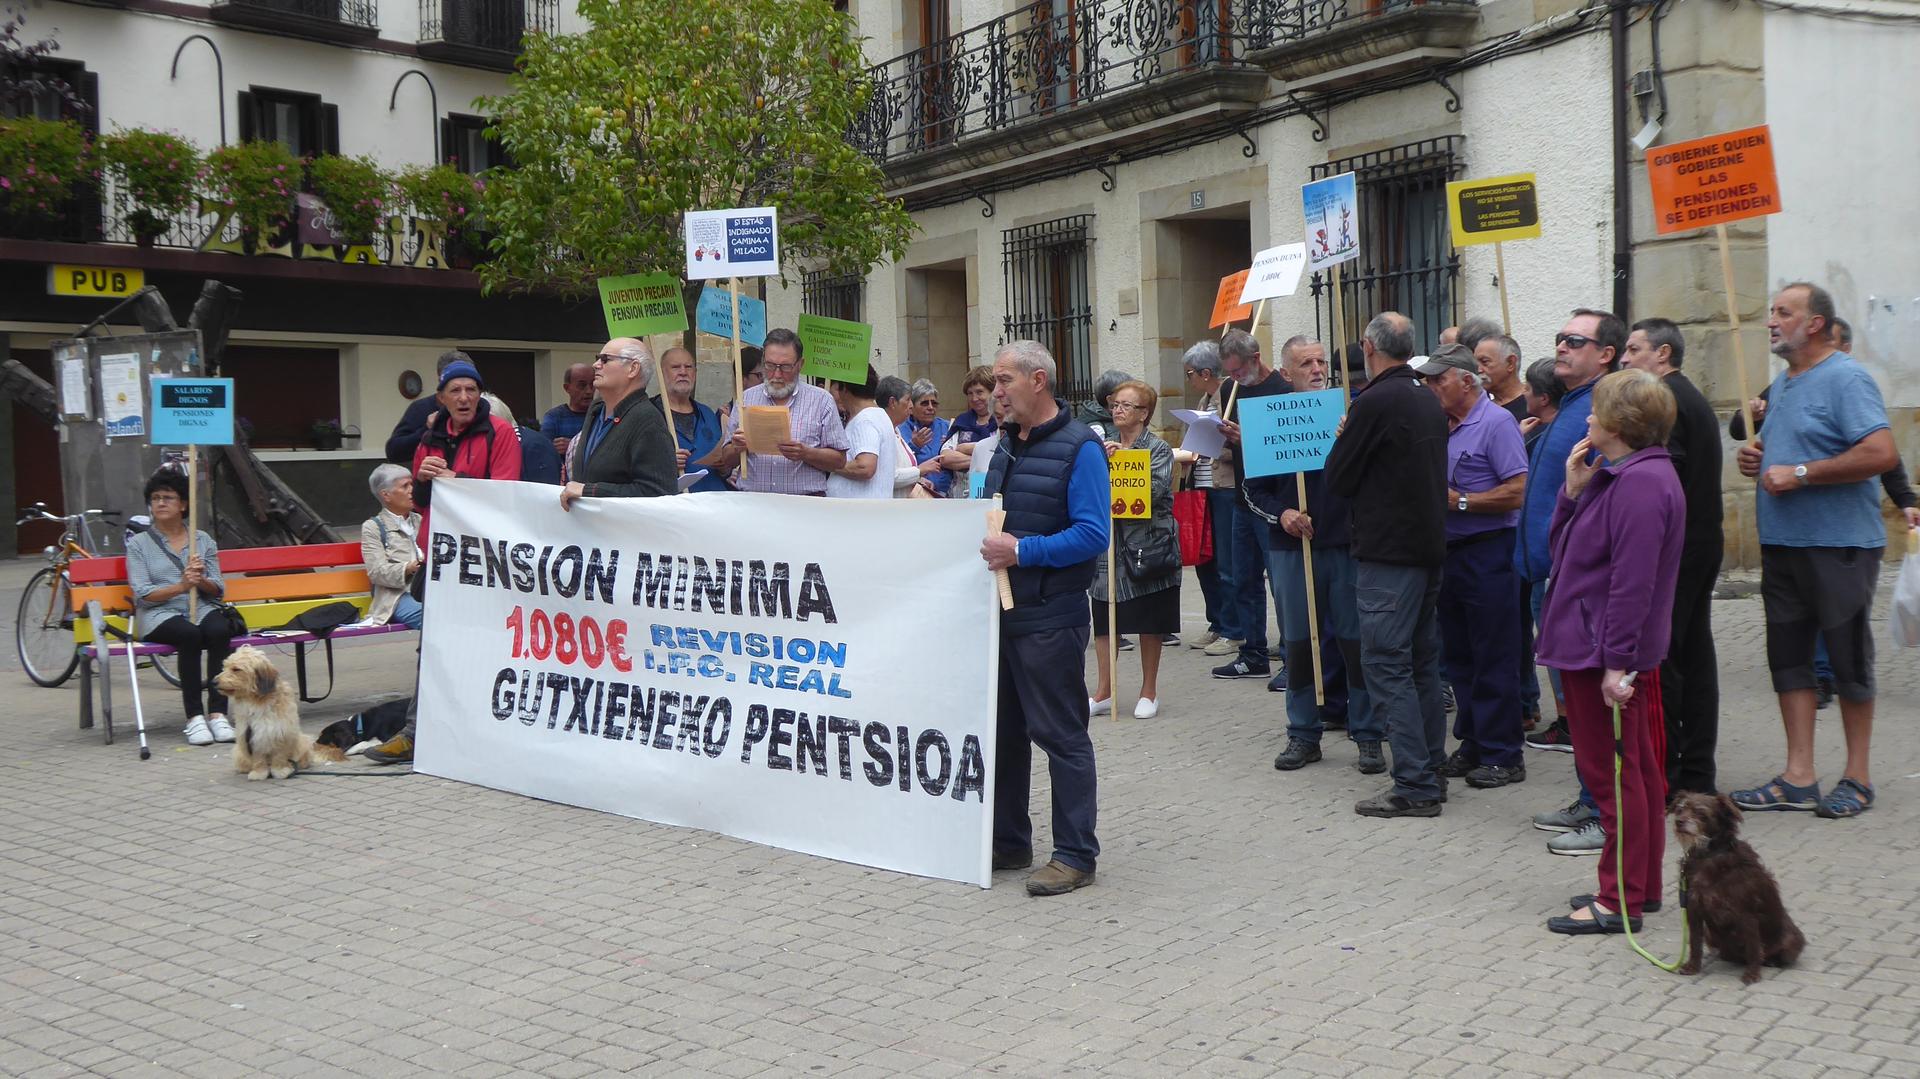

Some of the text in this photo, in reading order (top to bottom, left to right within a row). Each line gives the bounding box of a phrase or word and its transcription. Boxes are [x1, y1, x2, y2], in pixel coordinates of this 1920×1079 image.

[1654, 135, 1765, 166] GOBIERNE QUIEN
[1677, 153, 1745, 175] GOBIERNE
[1698, 172, 1728, 186] LAS
[1193, 192, 1202, 206] 15
[1674, 183, 1758, 208] PENSIONES
[1489, 210, 1520, 218] PENSIONES
[1666, 195, 1772, 224] SE DEFIENDEN
[728, 227, 771, 236] INDIGNADO
[72, 270, 126, 292] PUB
[608, 285, 677, 304] JUVENTUD PRECARIA
[611, 301, 679, 322] PENSION PRECARIA
[1266, 398, 1322, 412] SOLDATA
[1277, 415, 1314, 427] DUINA
[1264, 430, 1331, 445] PENTSIOAK
[1275, 447, 1322, 460] DUINAK
[1109, 462, 1145, 471] AY PAN
[1110, 478, 1146, 488] HORIZO
[431, 532, 838, 624] PENSION MINIMA
[506, 605, 633, 672] 1.080€
[650, 623, 847, 668] REVISION
[644, 649, 852, 699] I.P.C. REAL
[491, 667, 987, 804] GUTXIENEKO PENTSIOA
